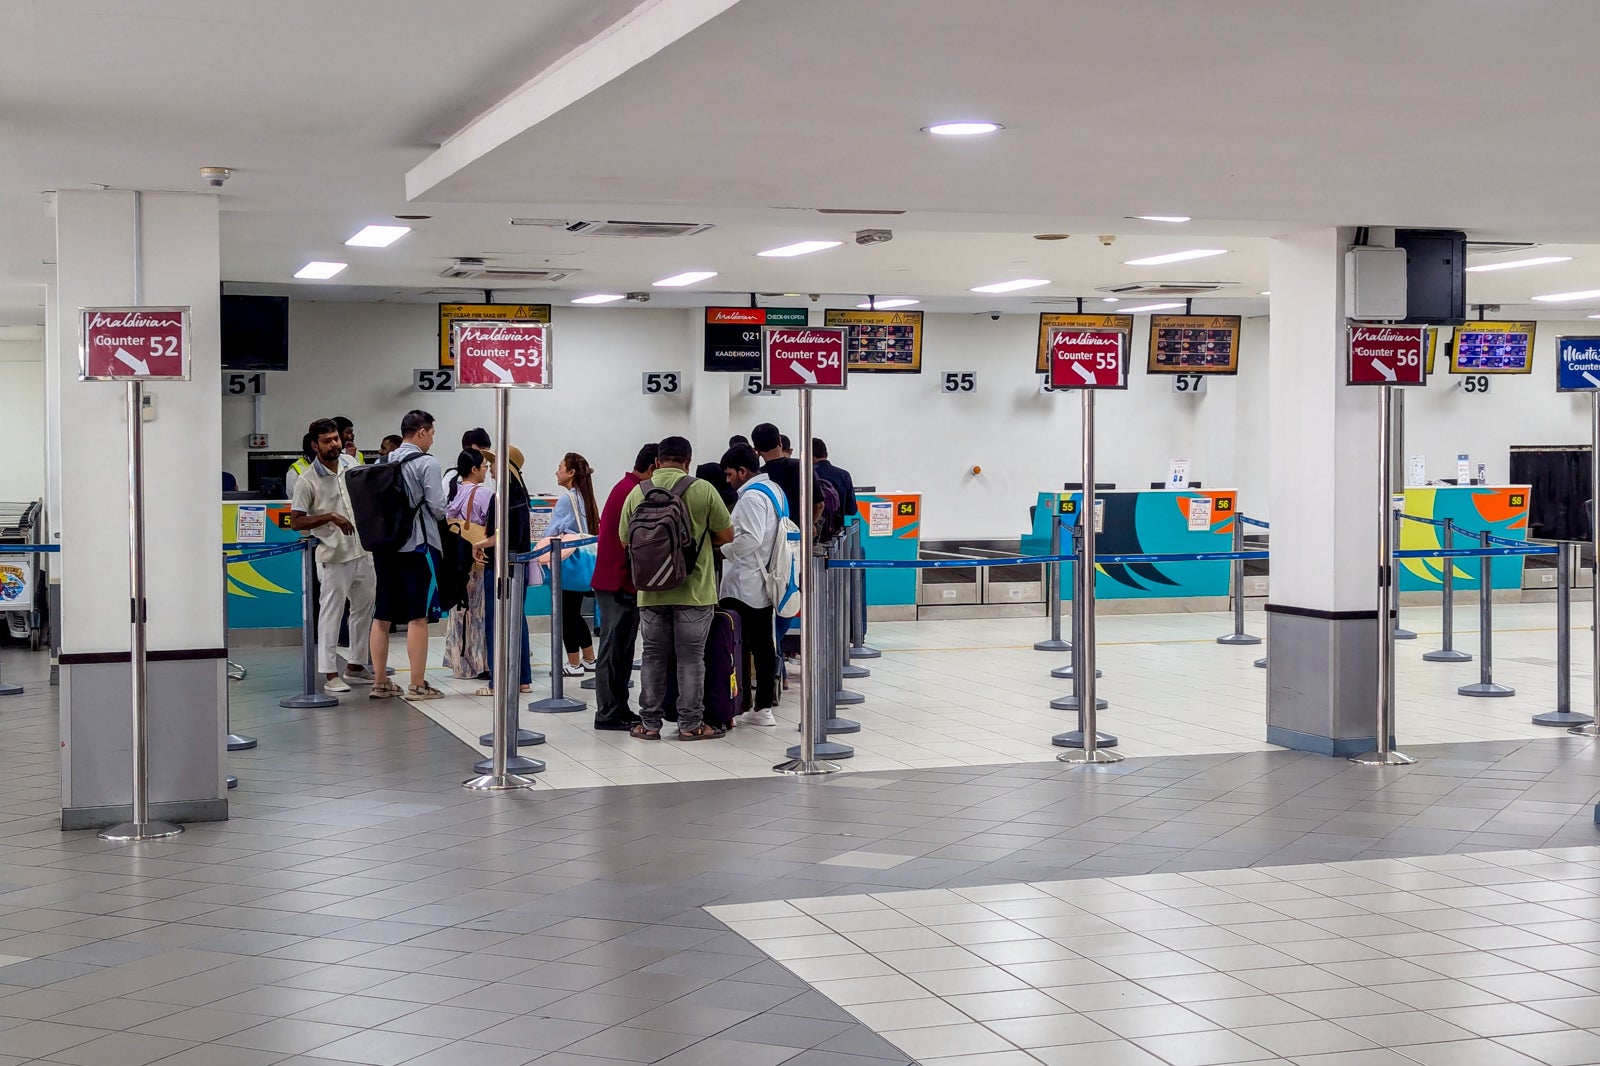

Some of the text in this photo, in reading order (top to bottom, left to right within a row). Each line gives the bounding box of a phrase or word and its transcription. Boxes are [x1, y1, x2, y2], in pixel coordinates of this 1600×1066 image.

[89, 312, 182, 329] Maldivian
[460, 327, 542, 342] Maldivian
[770, 330, 842, 344] Maldivian
[1053, 332, 1119, 346] Maldivian
[1352, 328, 1420, 342] Maldivian
[96, 335, 178, 356] Counter 52
[466, 347, 540, 367] Counter 53
[775, 349, 840, 368] Counter 54
[1058, 350, 1117, 370] Counter 55
[1357, 347, 1419, 366] Counter 56
[229, 374, 261, 394] 51
[418, 371, 452, 391] 52
[646, 373, 678, 393] 53
[945, 373, 974, 391] 55
[1176, 374, 1203, 391] 57
[1464, 376, 1489, 393] 59
[901, 504, 912, 513] 54
[1062, 502, 1074, 511] 55
[1218, 500, 1229, 509] 56
[1511, 496, 1522, 505] 58
